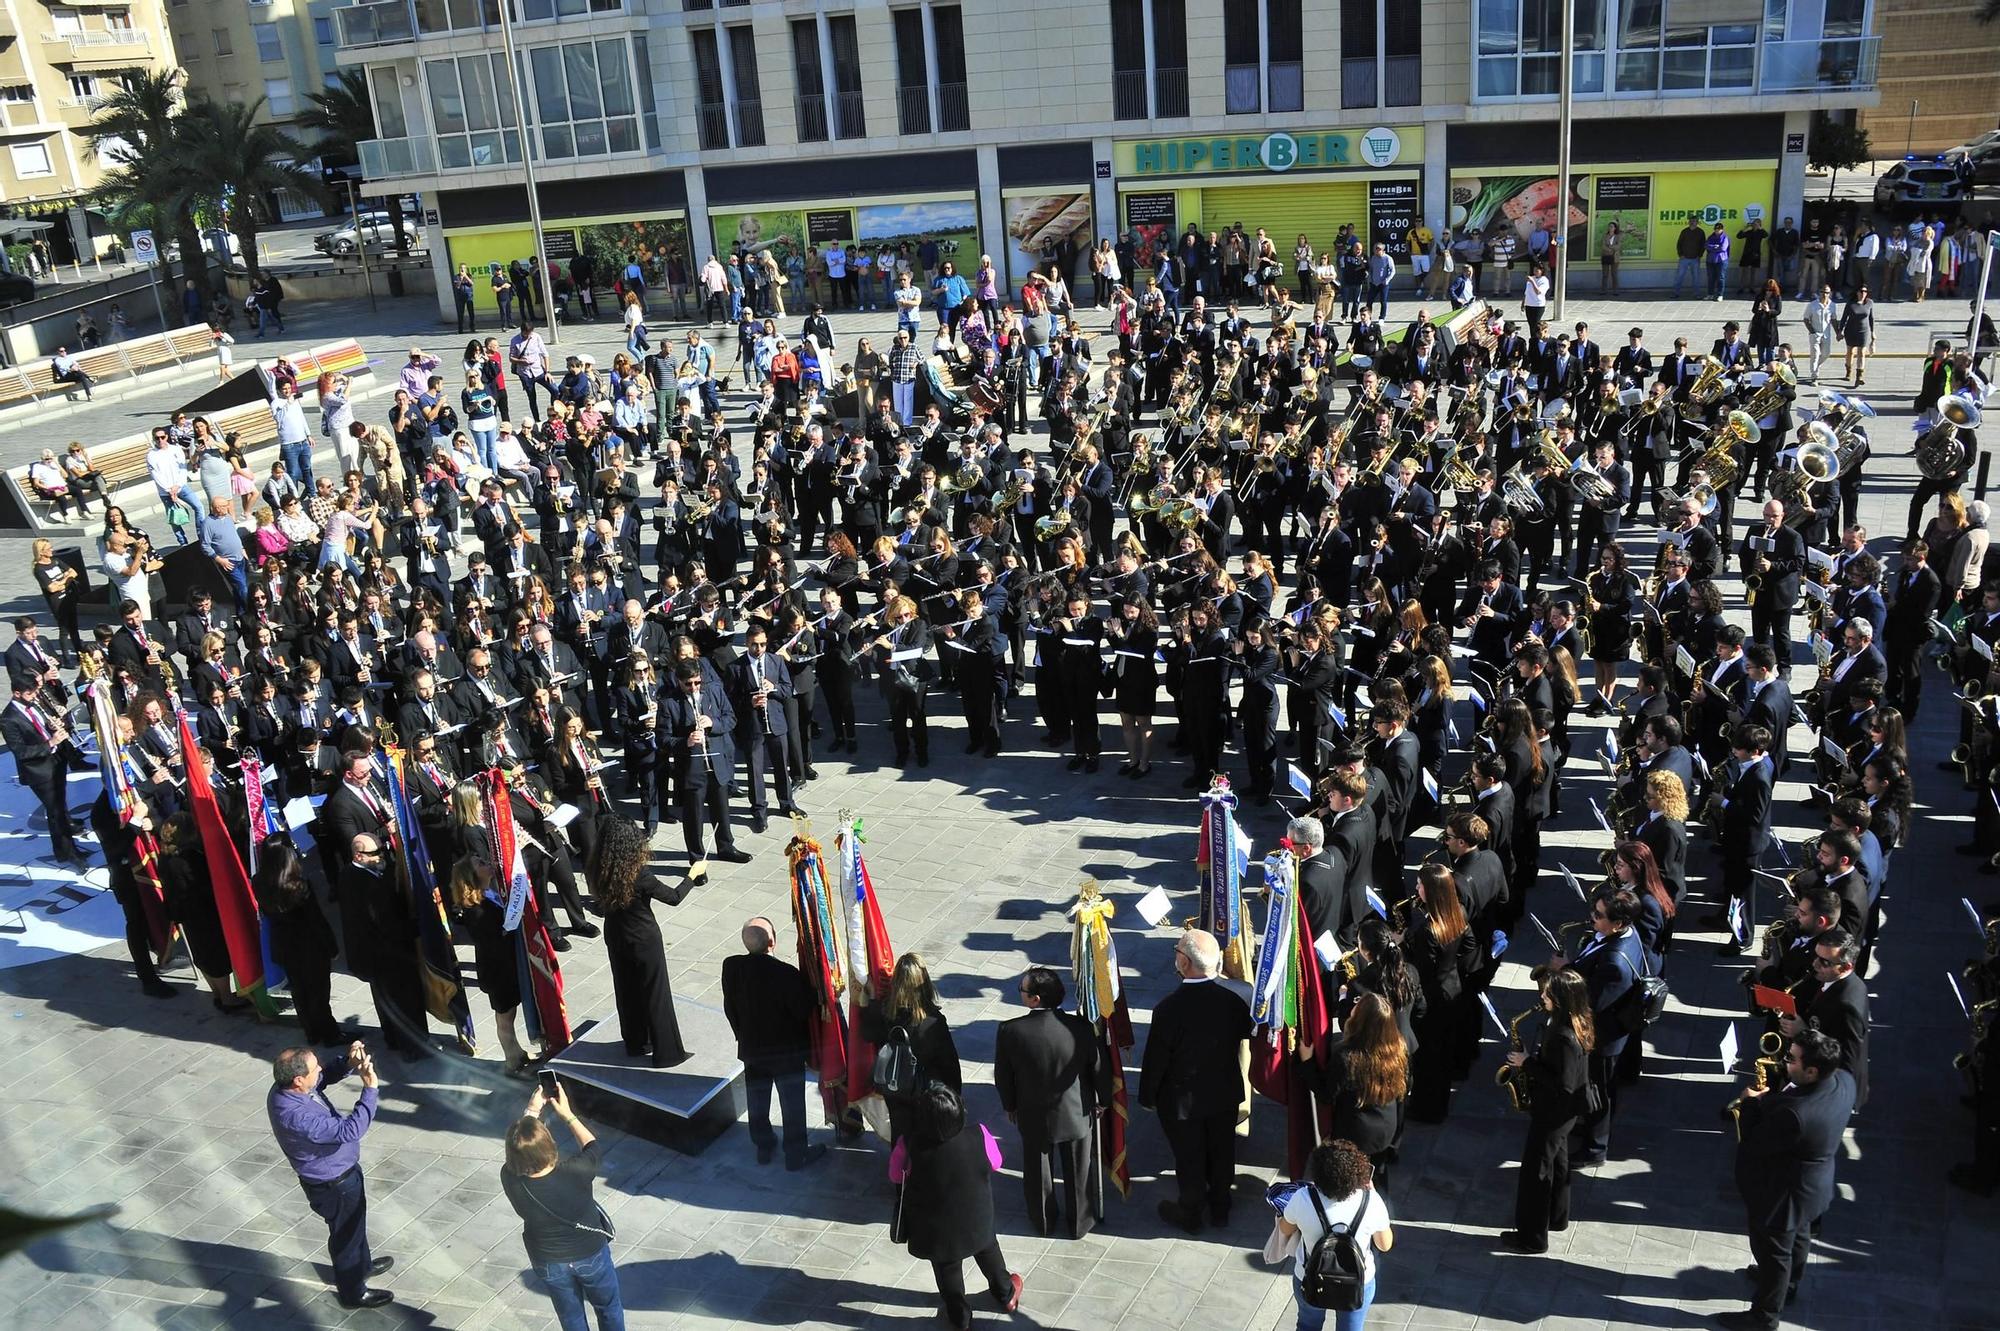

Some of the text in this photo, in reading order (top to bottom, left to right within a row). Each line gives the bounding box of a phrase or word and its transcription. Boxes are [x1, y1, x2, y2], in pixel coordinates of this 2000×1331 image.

[1135, 135, 1350, 173] HIPERBER
[1660, 207, 1738, 222] HIPERBER
[1378, 219, 1409, 228] 09:00
[1386, 243, 1407, 253] 1:45
[1216, 845, 1224, 854] DE
